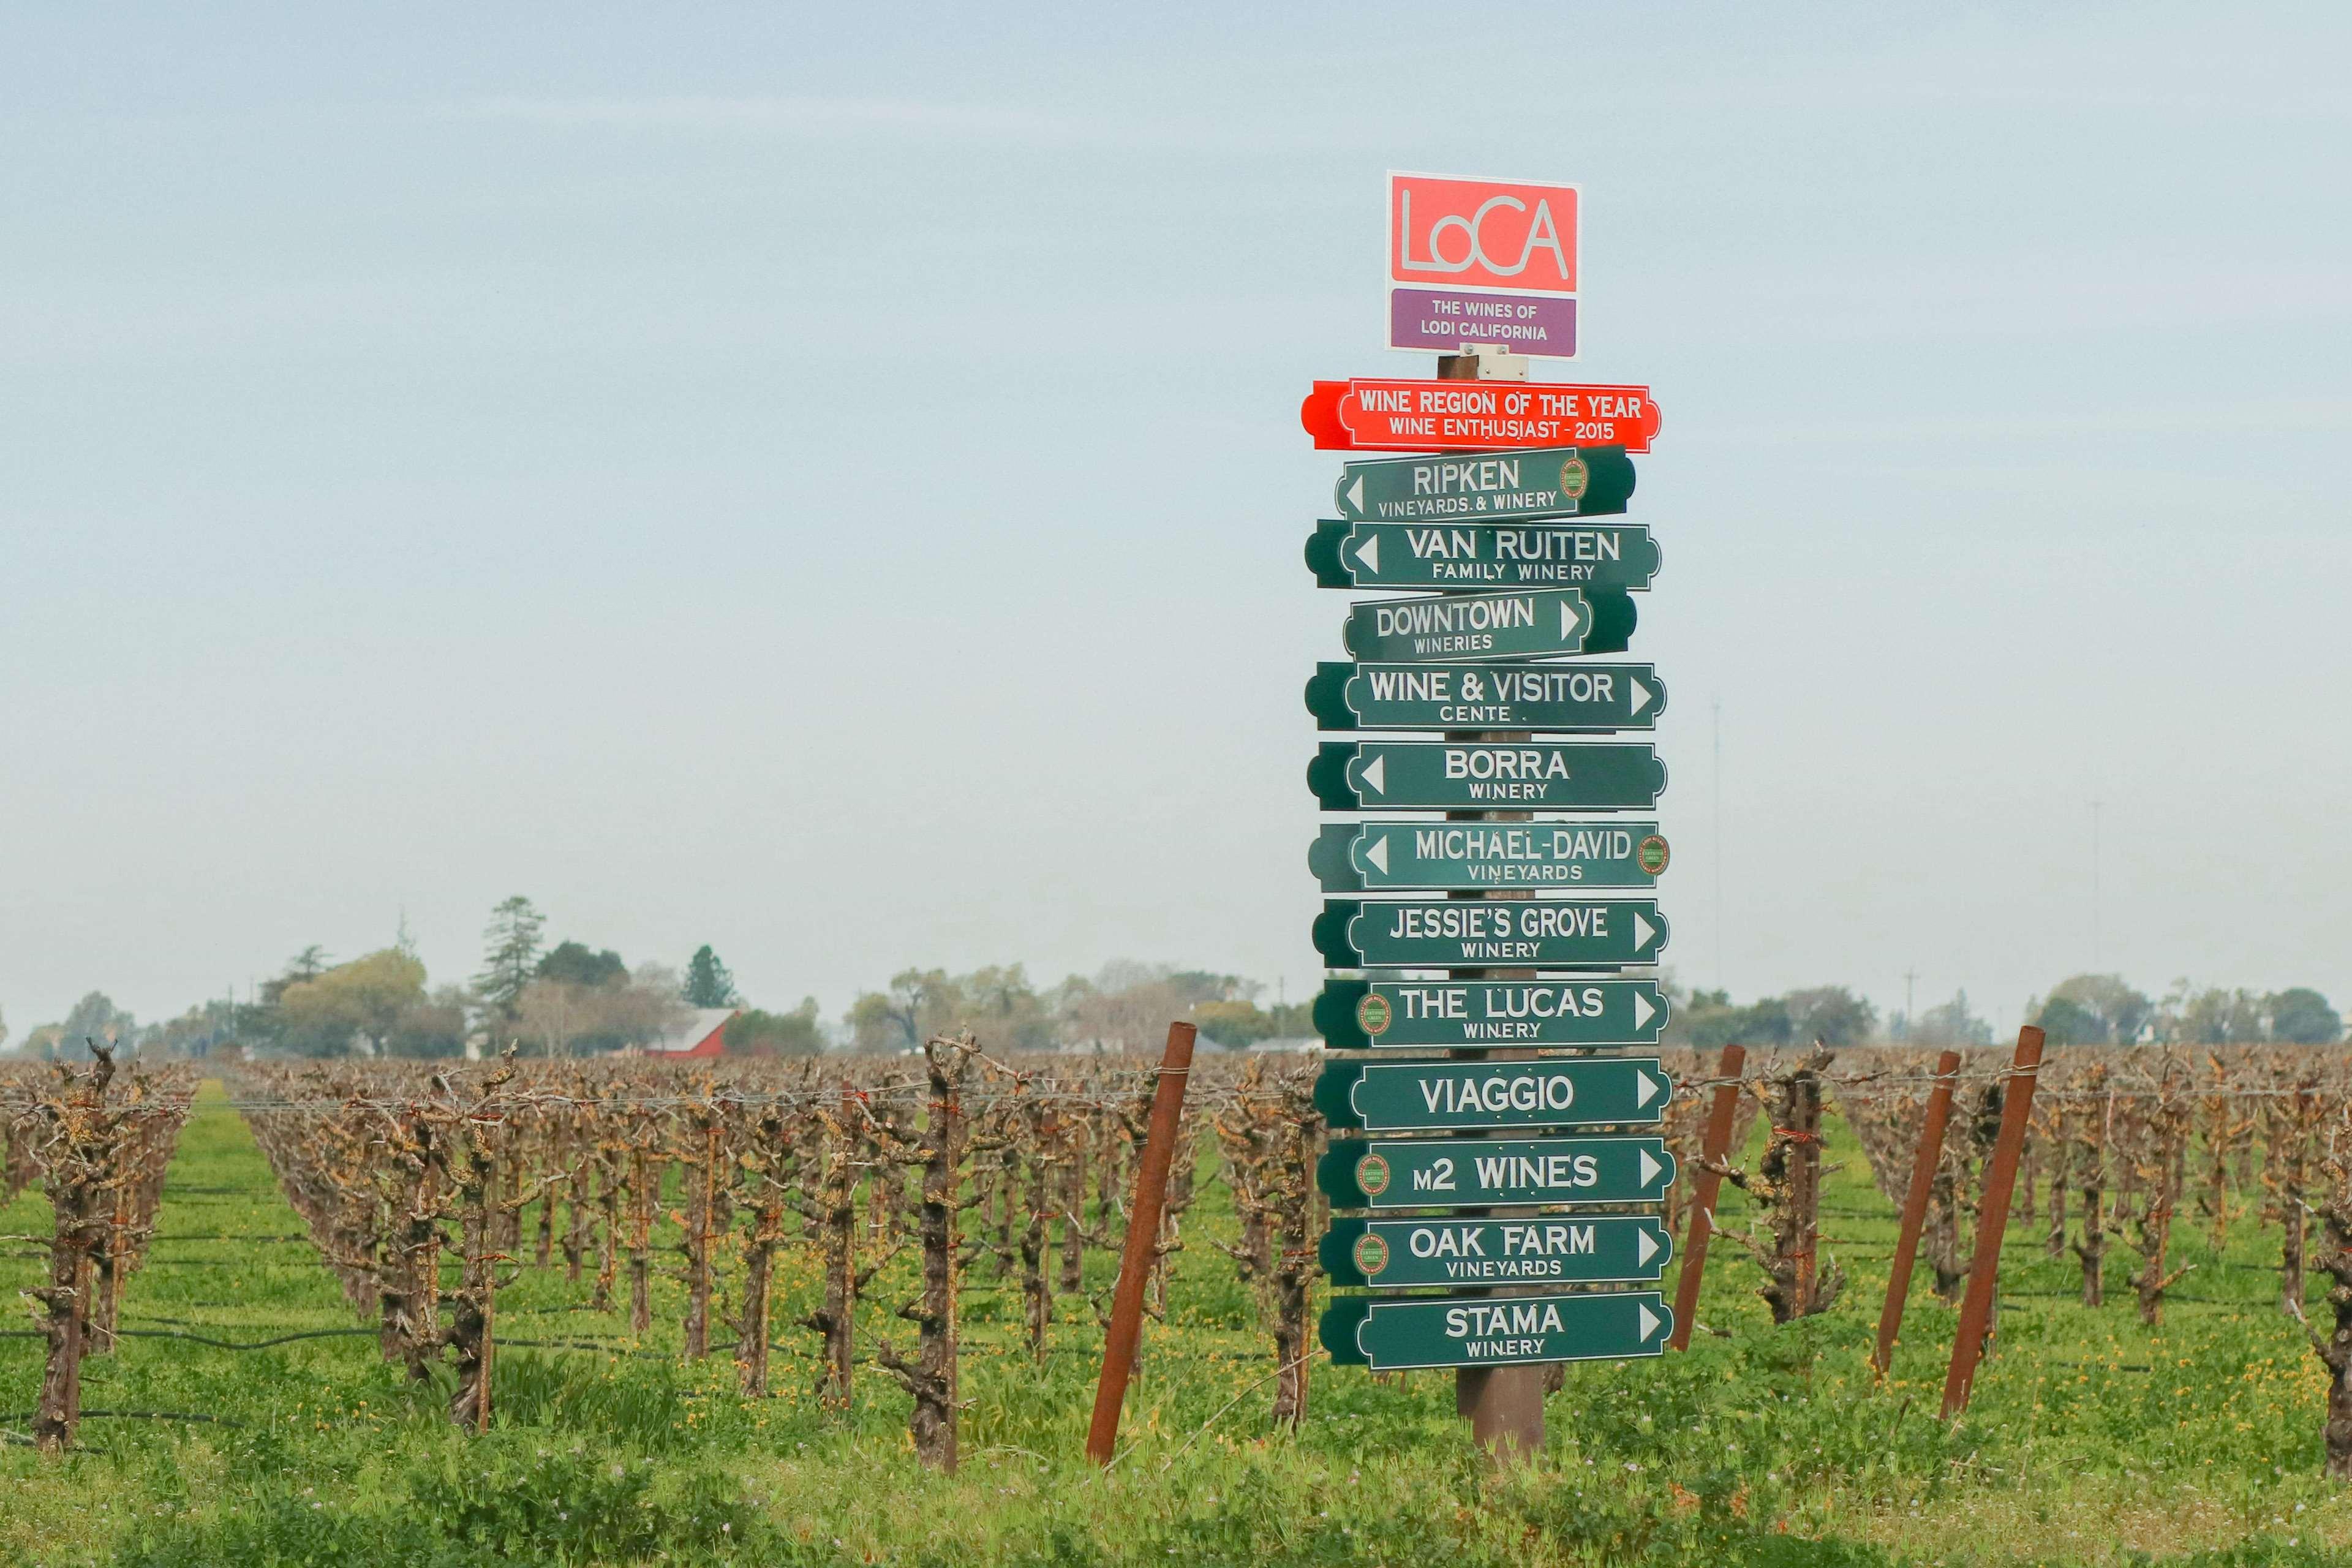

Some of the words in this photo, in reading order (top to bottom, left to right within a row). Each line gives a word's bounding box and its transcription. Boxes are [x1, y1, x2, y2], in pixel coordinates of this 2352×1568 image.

[1402, 189, 1569, 280] LoCA
[1432, 300, 1461, 315] THE
[1464, 301, 1513, 318] WINES
[1517, 305, 1537, 319] OF
[1421, 320, 1455, 335] LODI
[1459, 322, 1547, 341] CALIFORNIA
[1359, 390, 1412, 413] WINE
[1420, 391, 1496, 415] REGION
[1504, 393, 1532, 415] OF
[1539, 394, 1579, 417] THE
[1587, 396, 1642, 418] YEAR
[1389, 417, 1436, 435] WINE
[1444, 418, 1561, 438] ENTHUSIAST
[1575, 421, 1615, 440] 2015
[1414, 459, 1520, 496] RIPKEN
[1378, 497, 1469, 518] VINEYARDS
[1476, 496, 1487, 511] &
[1493, 491, 1557, 510] WINERY
[1404, 529, 1477, 559] VAN
[1496, 530, 1621, 561] RUITEN
[1433, 563, 1506, 581] FAMILY
[1517, 564, 1595, 581] WINERY
[1376, 598, 1534, 638] DOWNTOWN
[1414, 634, 1493, 654] WINERIES
[1368, 671, 1451, 702] WINE
[1461, 672, 1483, 701] &
[1490, 673, 1615, 702] VISITOR
[1439, 706, 1510, 722] CENTE
[1444, 750, 1570, 779] BORRA
[1468, 783, 1548, 799] WINERY
[1415, 830, 1631, 861] MICHAEL-DAVID
[1467, 865, 1582, 881] VINEYARDS
[1389, 907, 1511, 939] JESSIE'S
[1520, 907, 1608, 937] GROVE
[1461, 942, 1540, 958] WINERY
[1398, 989, 1468, 1019] THE
[1485, 987, 1604, 1019] LUCAS
[1463, 1022, 1541, 1039] WINERY
[1418, 1075, 1574, 1115] VIAGGIO
[1474, 1154, 1597, 1189] WINES
[1409, 1227, 1486, 1258] OAK
[1502, 1224, 1595, 1256] FARM
[1445, 1259, 1561, 1278] VINEYARDS
[1444, 1303, 1565, 1338] STAMA
[1466, 1338, 1545, 1357] WINERY
